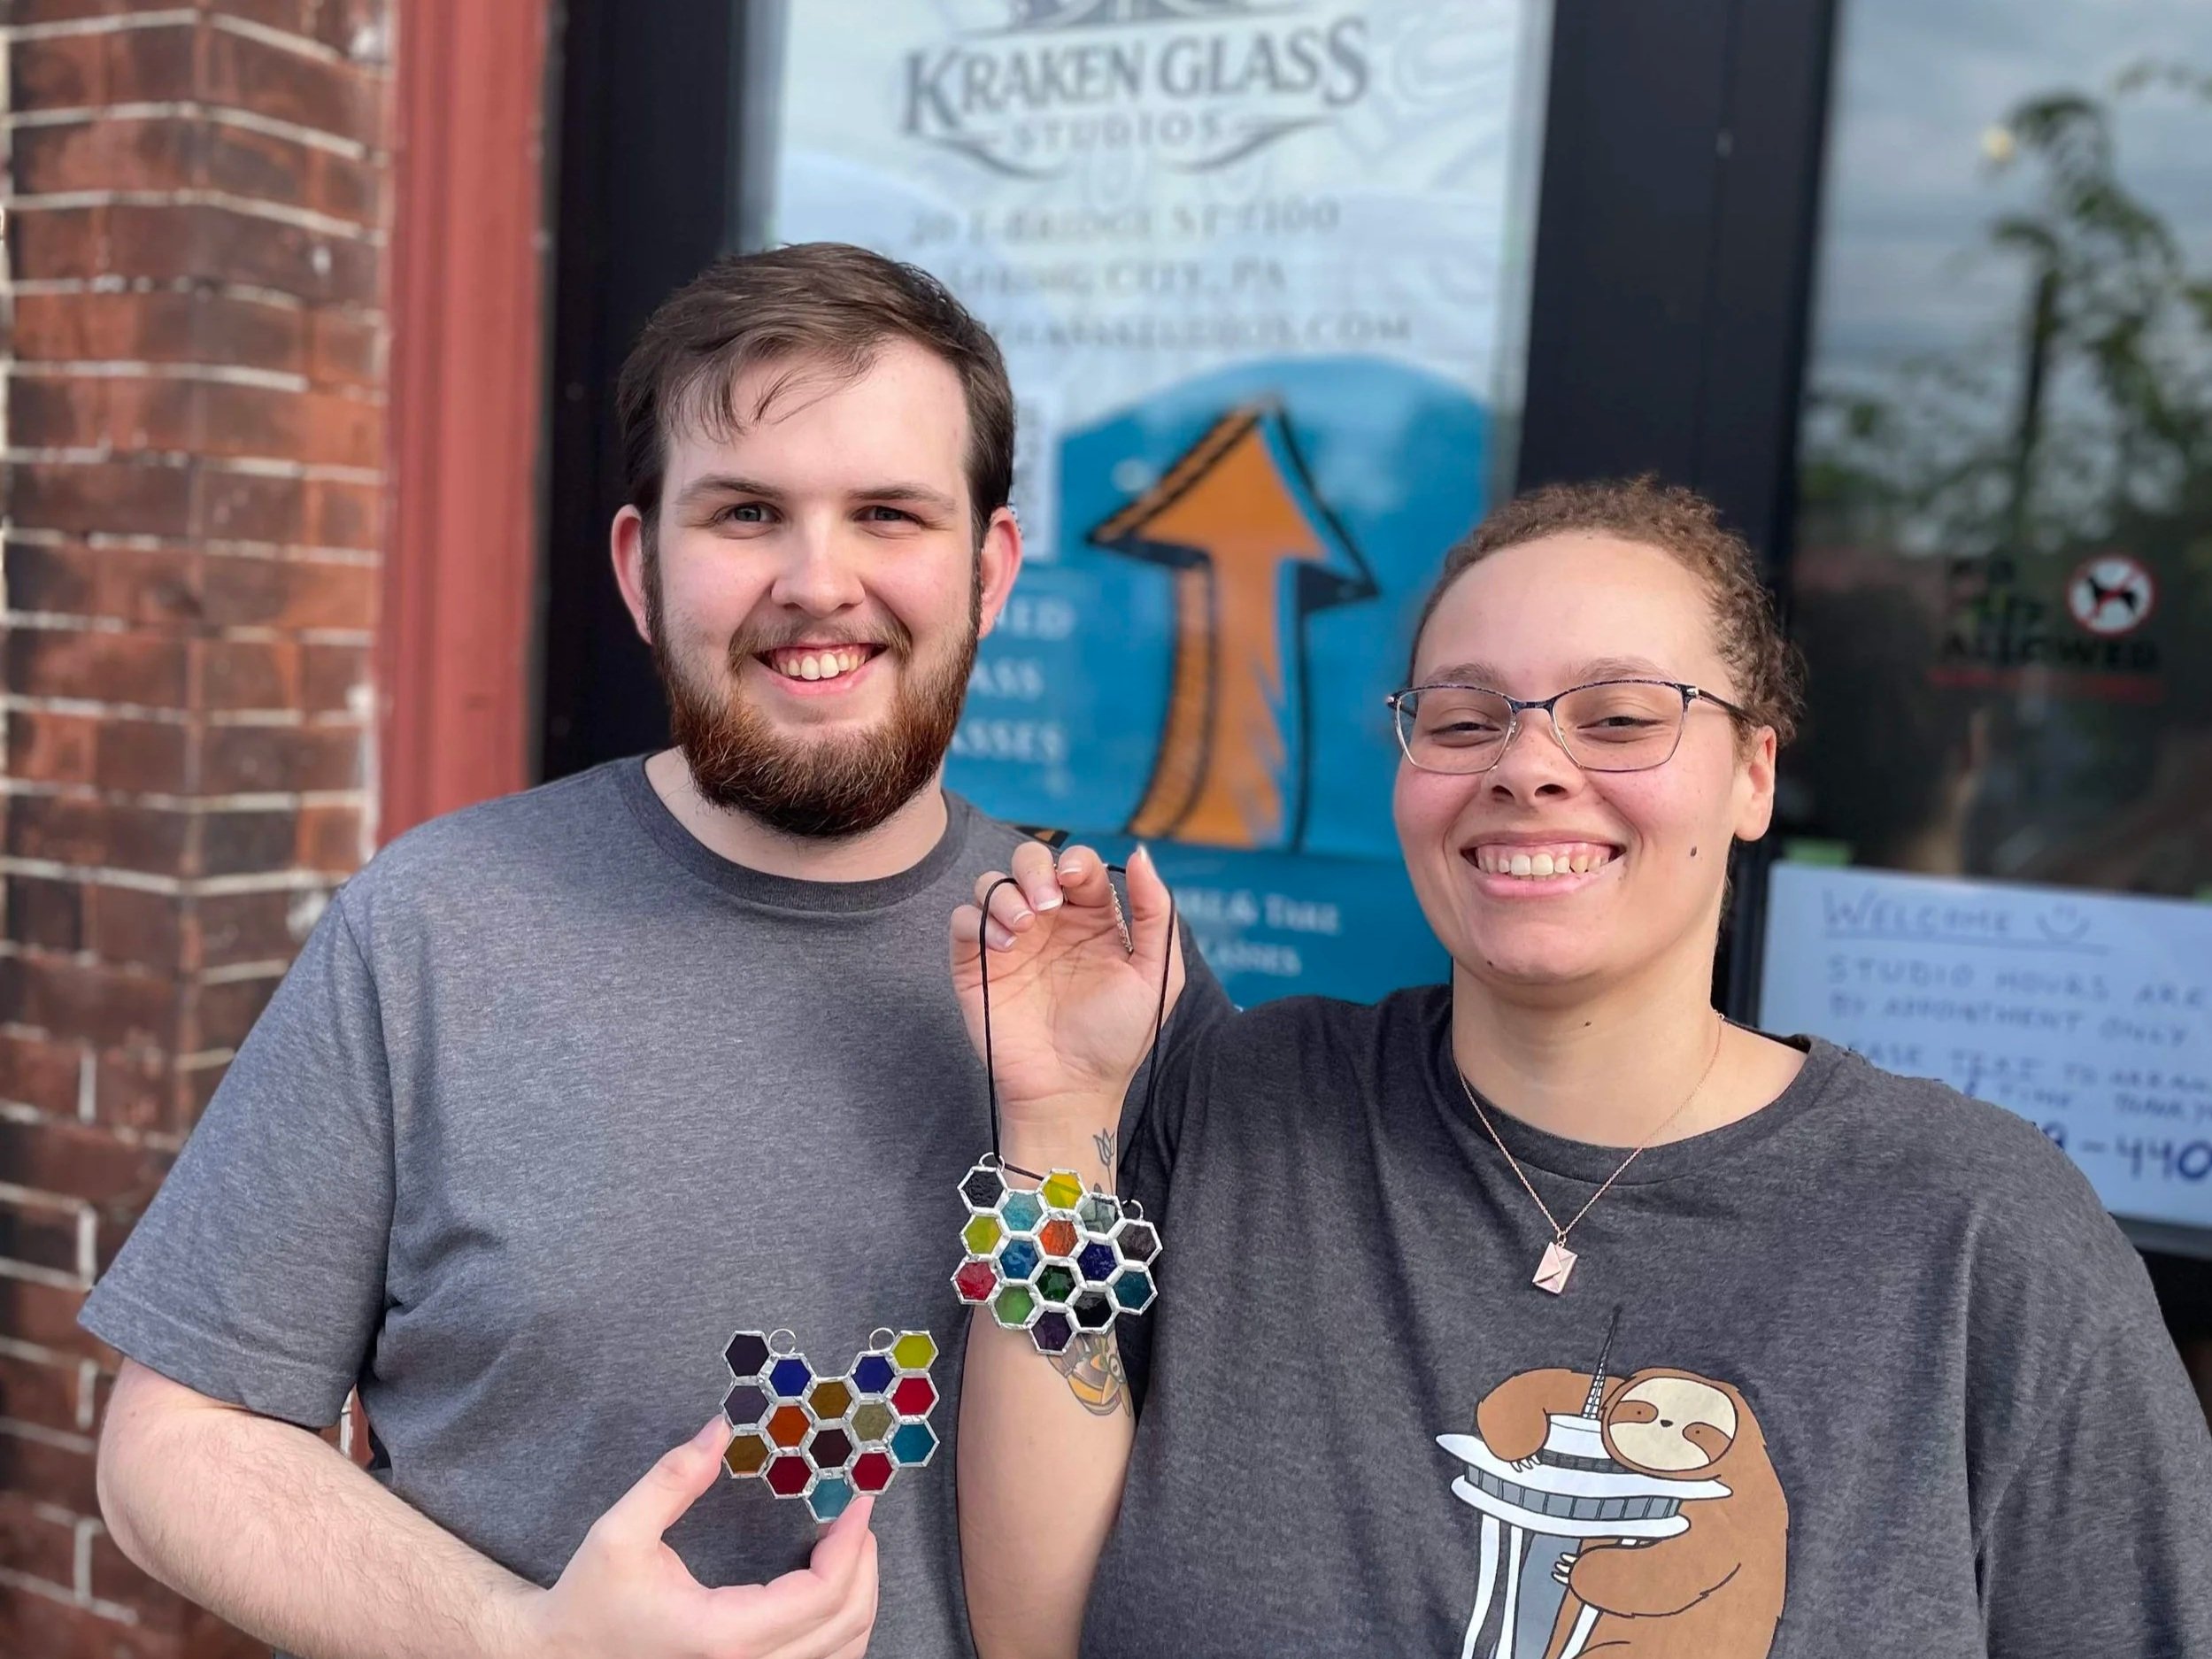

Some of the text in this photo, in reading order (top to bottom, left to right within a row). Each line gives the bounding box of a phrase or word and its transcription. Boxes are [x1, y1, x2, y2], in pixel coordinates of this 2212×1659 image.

[898, 14, 1371, 135] KRAKEN GLASS
[1012, 110, 1222, 154] STUDIOS
[1822, 886, 2013, 936] WELCOME
[1826, 953, 2207, 1010] STUDIO HOURS ARE
[1884, 994, 2084, 1033] APPOINTMENT
